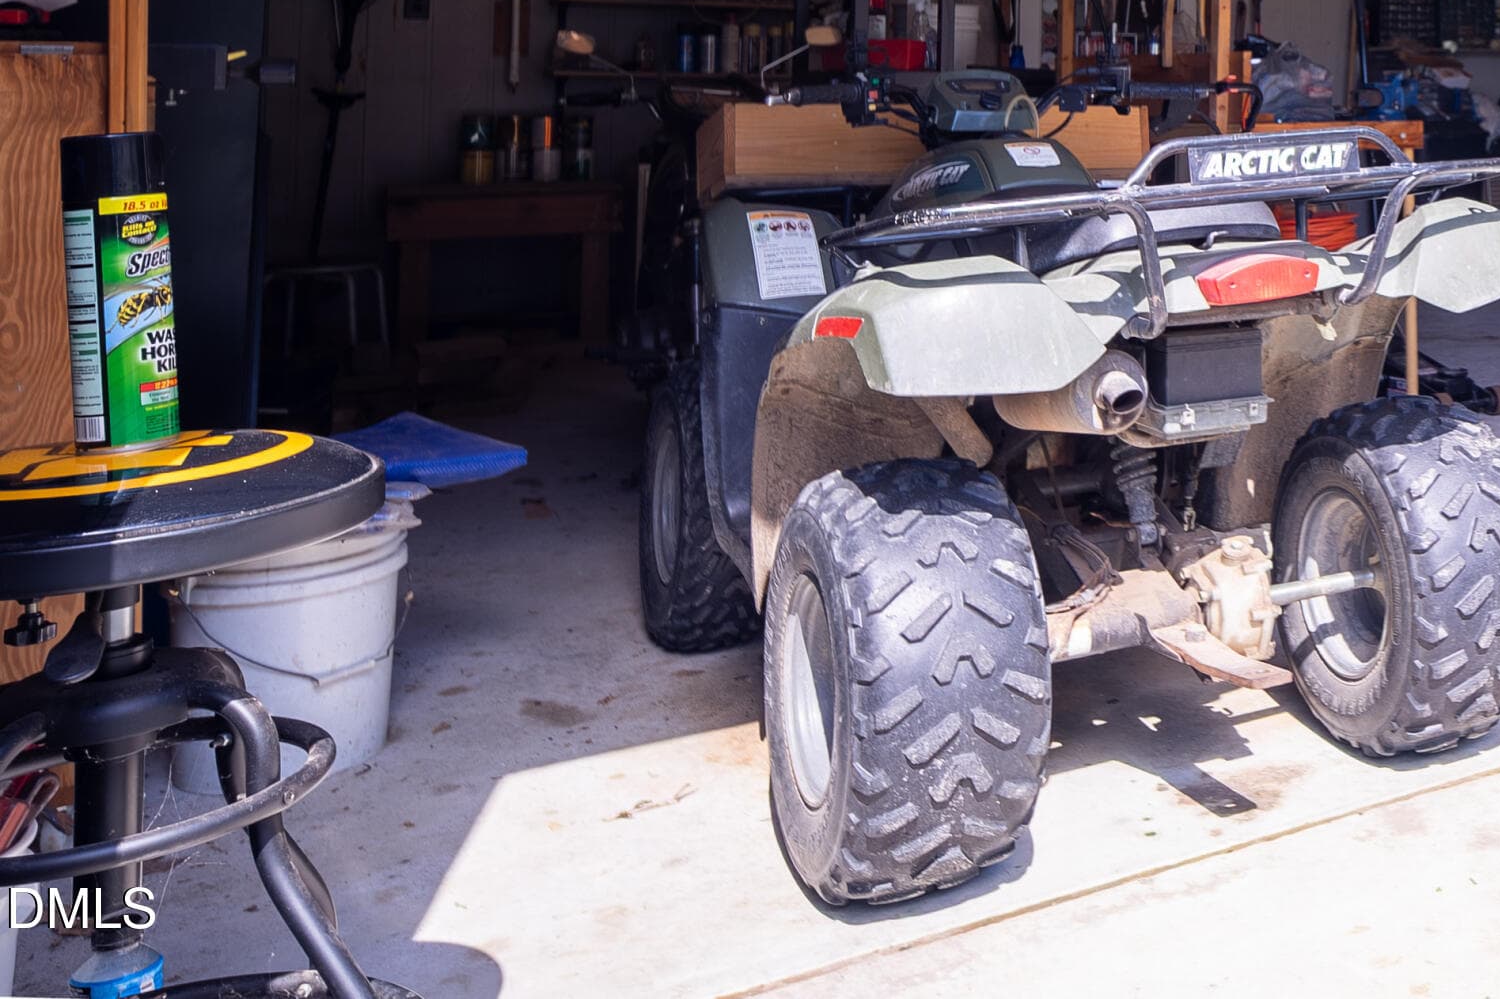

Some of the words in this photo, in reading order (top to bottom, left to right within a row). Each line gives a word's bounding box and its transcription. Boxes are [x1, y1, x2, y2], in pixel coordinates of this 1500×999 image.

[1202, 147, 1296, 179] ARCTIC
[1300, 142, 1350, 170] CAT
[123, 200, 146, 211] 18.5
